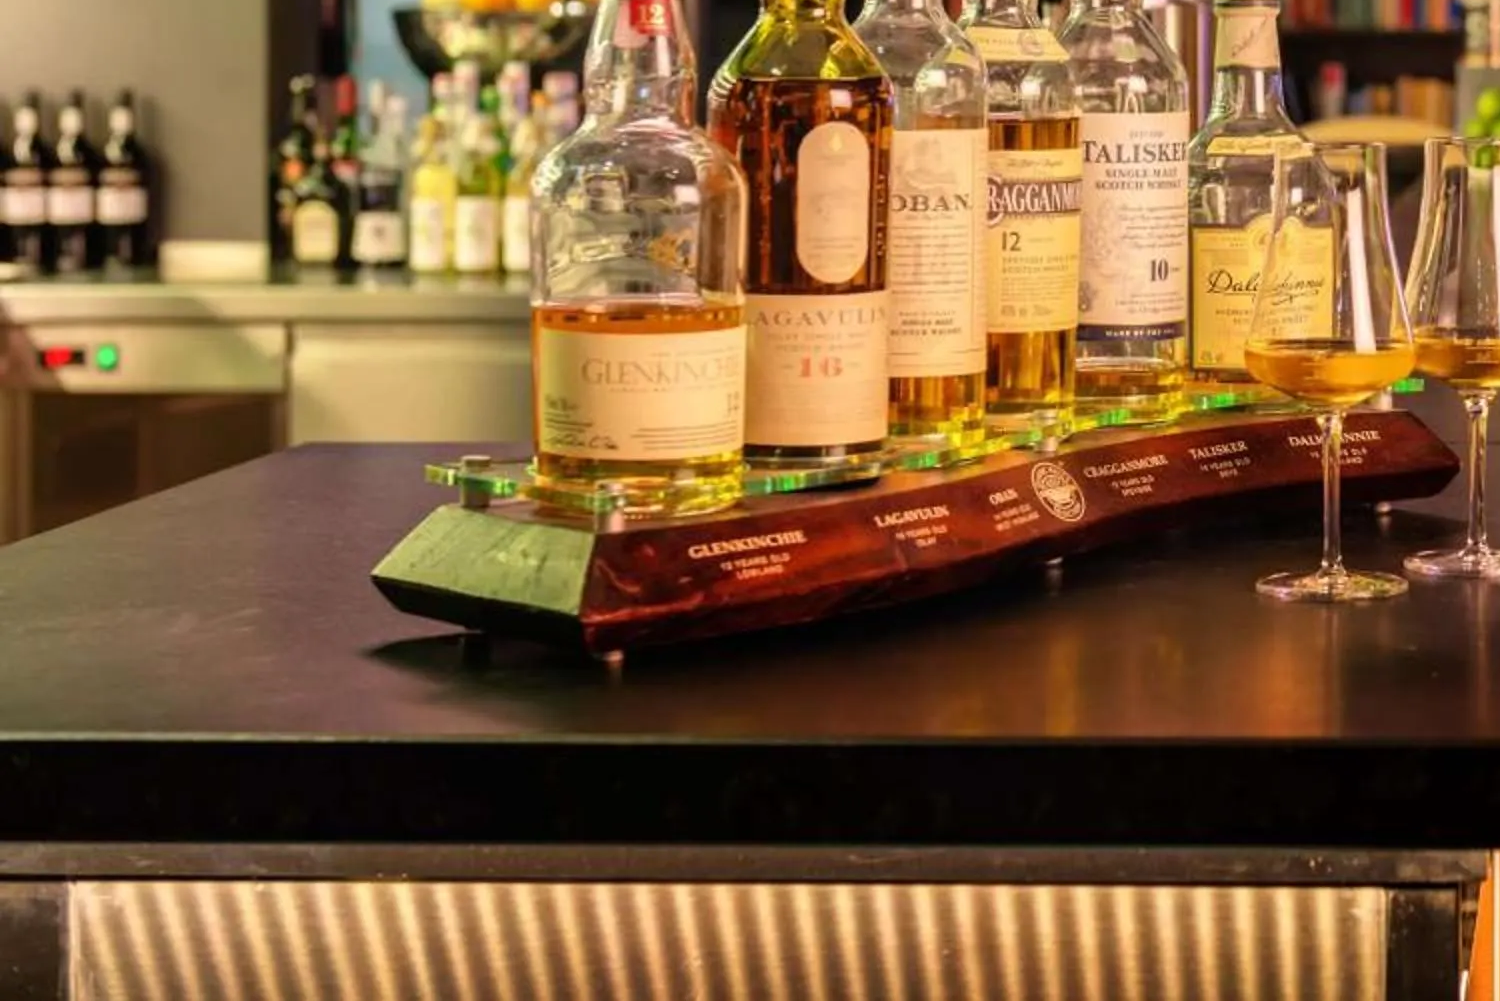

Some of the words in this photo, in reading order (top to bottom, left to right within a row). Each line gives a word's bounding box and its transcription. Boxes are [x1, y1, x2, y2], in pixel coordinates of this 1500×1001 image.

[1001, 231, 1021, 252] 12
[1150, 258, 1169, 282] 10
[1207, 268, 1325, 298] Dalhinnie
[797, 356, 843, 378] 16
[1187, 440, 1249, 460] TALISKER
[1287, 430, 1382, 448] DALNNIE
[688, 529, 808, 559] GLENKINCHIE
